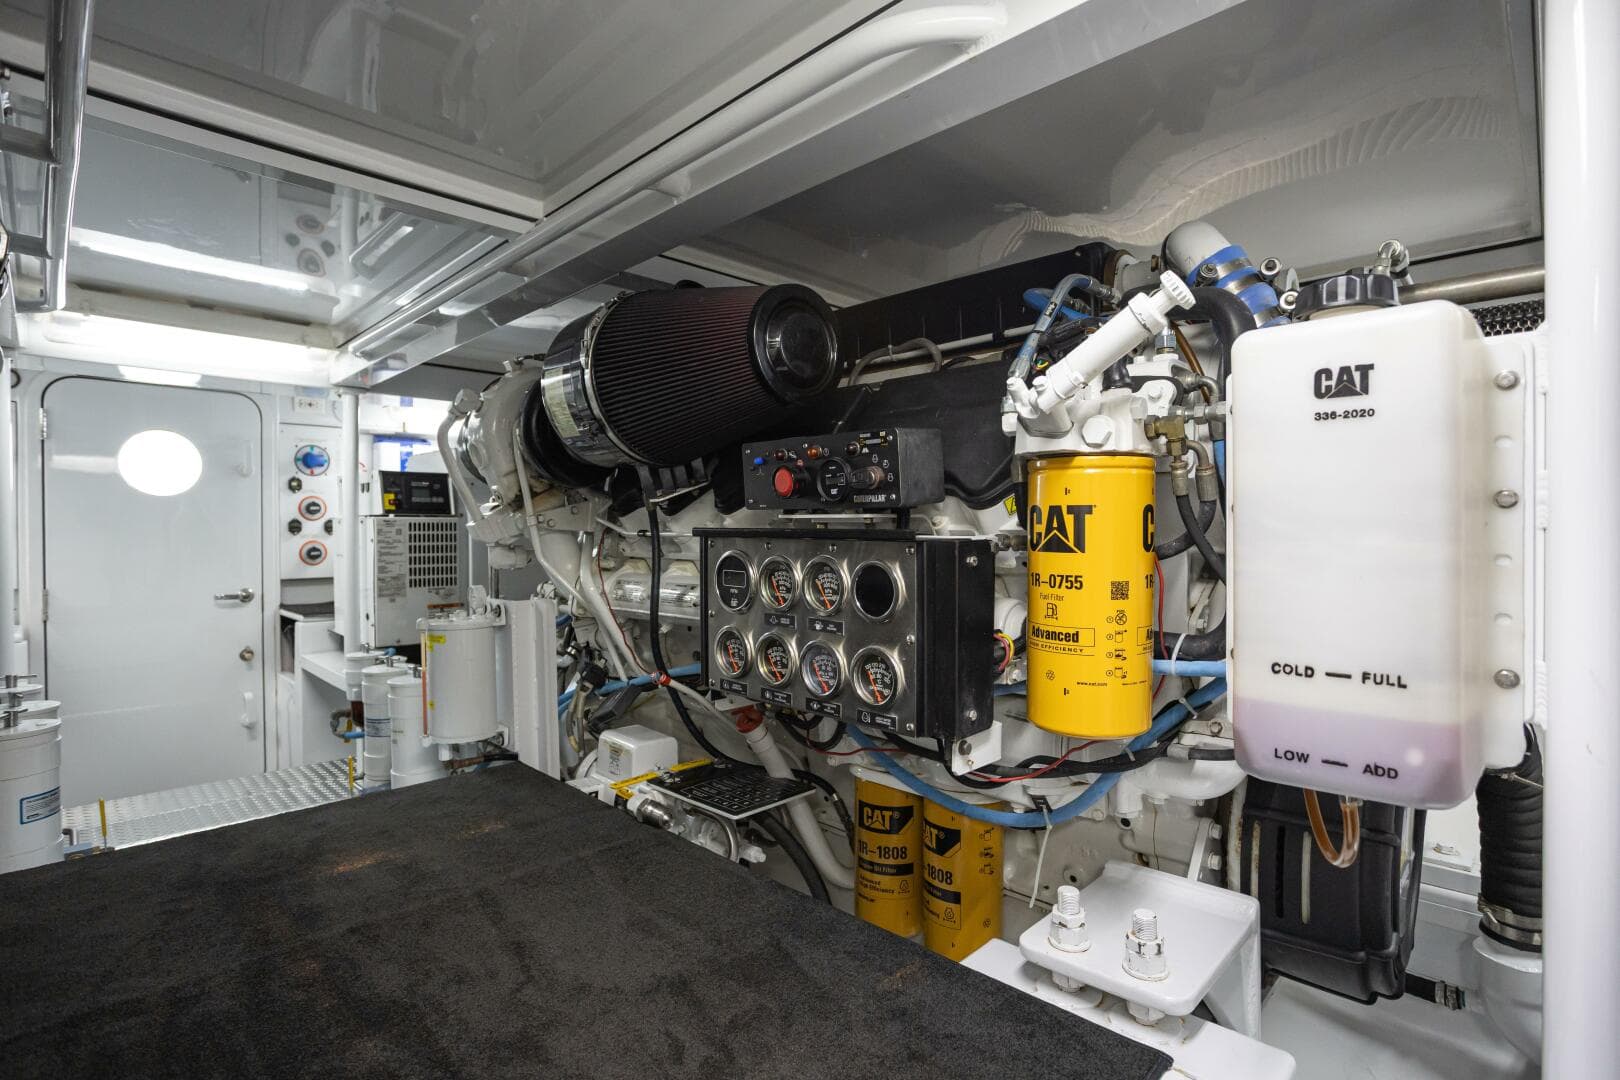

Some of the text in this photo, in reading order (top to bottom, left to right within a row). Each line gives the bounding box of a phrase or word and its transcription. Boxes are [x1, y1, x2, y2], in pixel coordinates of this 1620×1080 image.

[1313, 363, 1375, 400] CAT
[1314, 408, 1376, 422] 336-2020
[1030, 504, 1093, 553] CAT
[1030, 573, 1084, 591] 1R-0755
[1031, 625, 1079, 643] Advanced
[1271, 662, 1407, 689] COLD FULL
[1274, 748, 1399, 780] LOW ADD
[863, 806, 893, 832] CAT
[858, 839, 907, 860] 1R-1808
